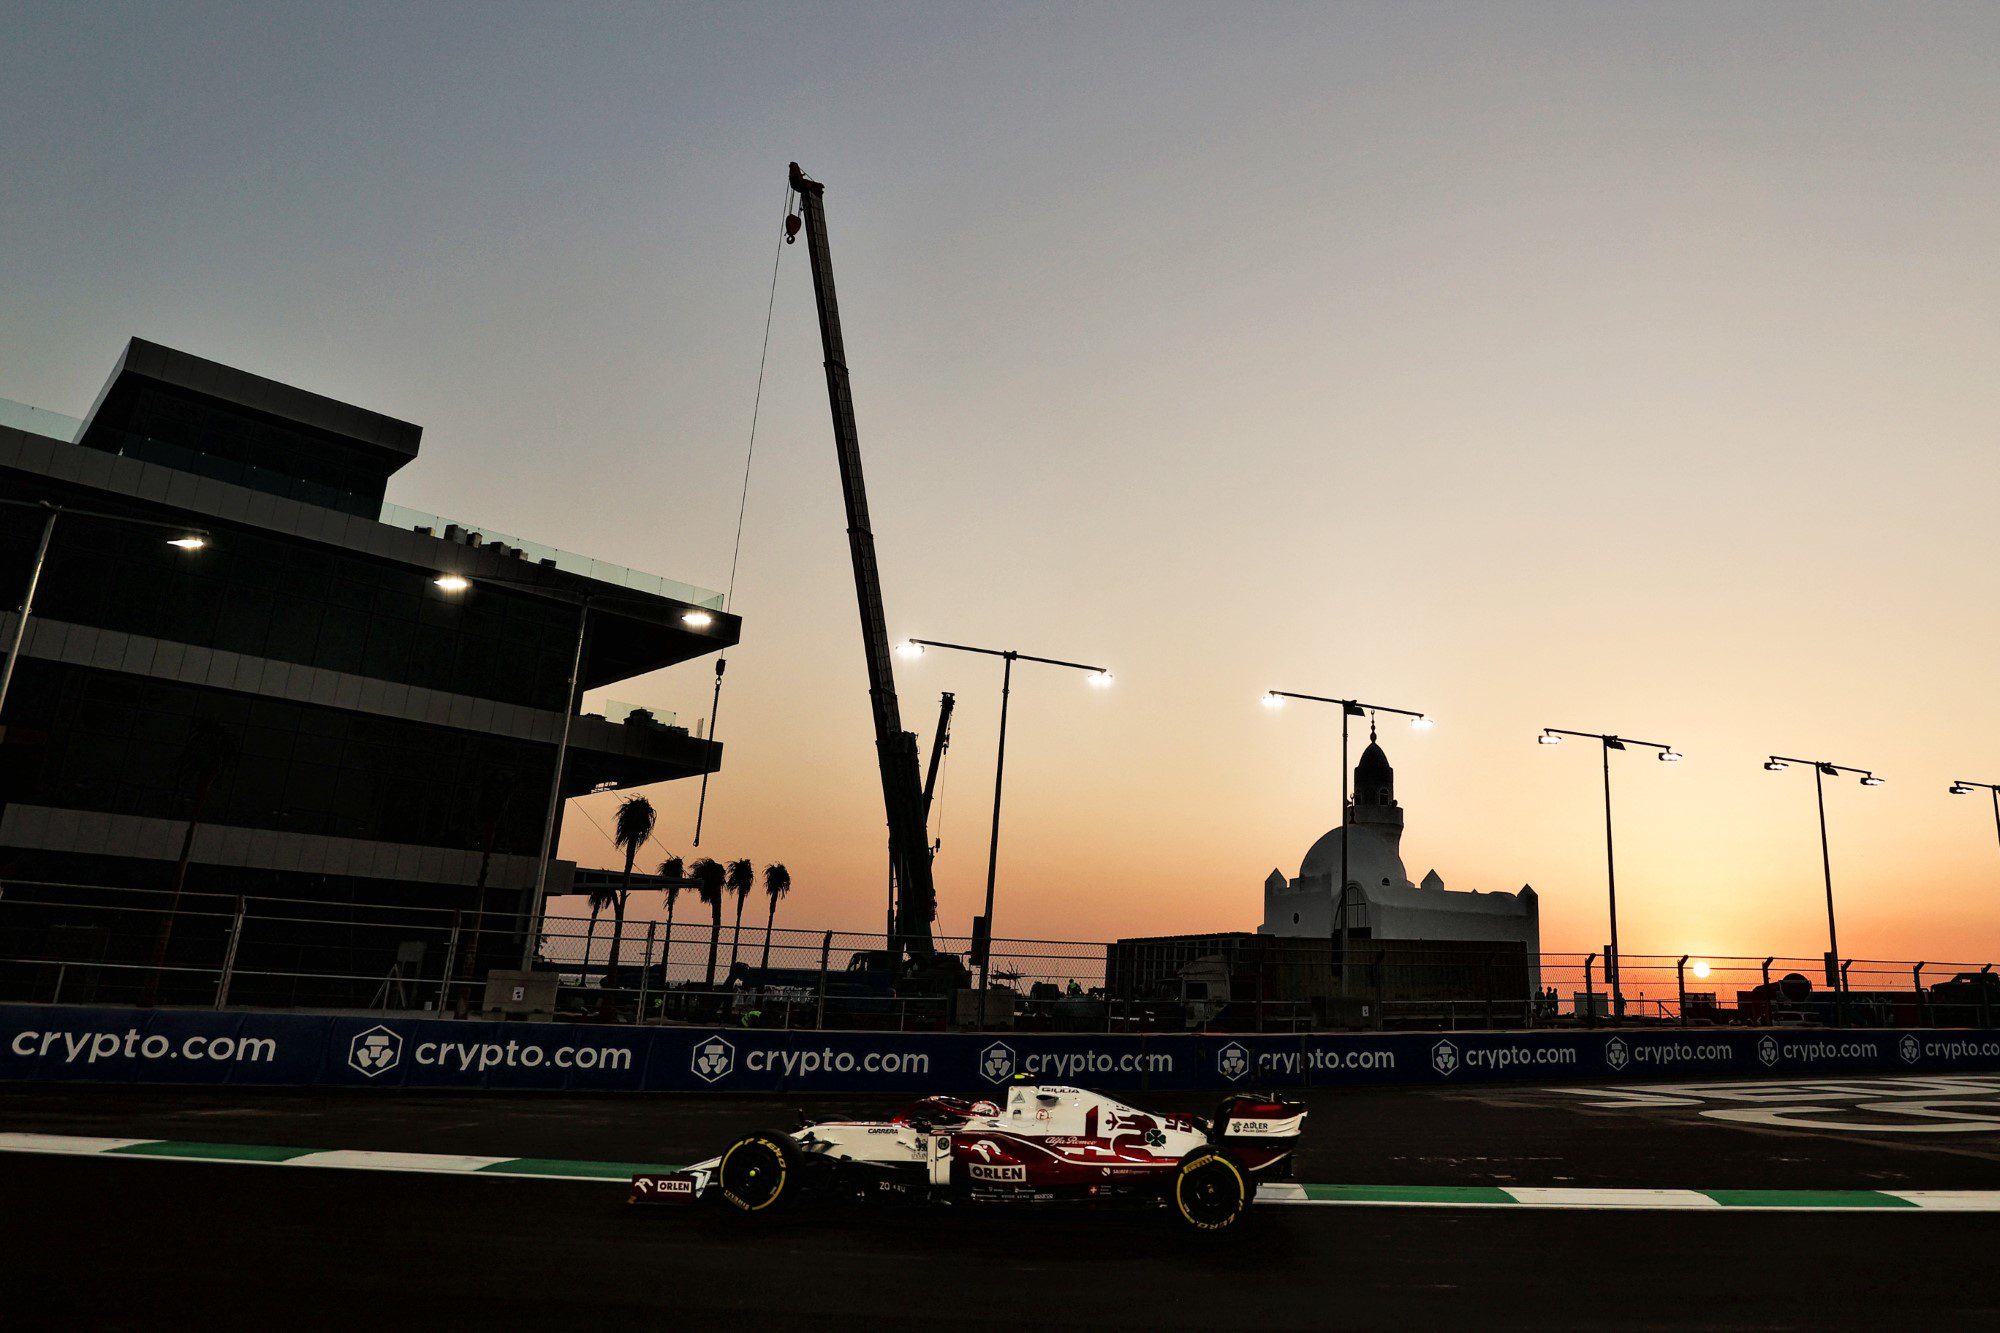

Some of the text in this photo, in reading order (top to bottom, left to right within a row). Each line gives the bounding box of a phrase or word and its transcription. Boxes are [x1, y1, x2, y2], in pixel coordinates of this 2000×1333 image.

[11, 1028, 276, 1064] crypto.com
[415, 1040, 632, 1072] crypto.com
[1465, 1045, 1577, 1069] crypto.com
[1634, 1043, 1733, 1066] crypto.com
[1783, 1041, 1878, 1063] crypto.com
[746, 1047, 930, 1077] crypto.com
[1243, 1121, 1269, 1130] ADLER
[971, 1167, 1023, 1180] ORLEN
[659, 1182, 690, 1191] ORLEN
